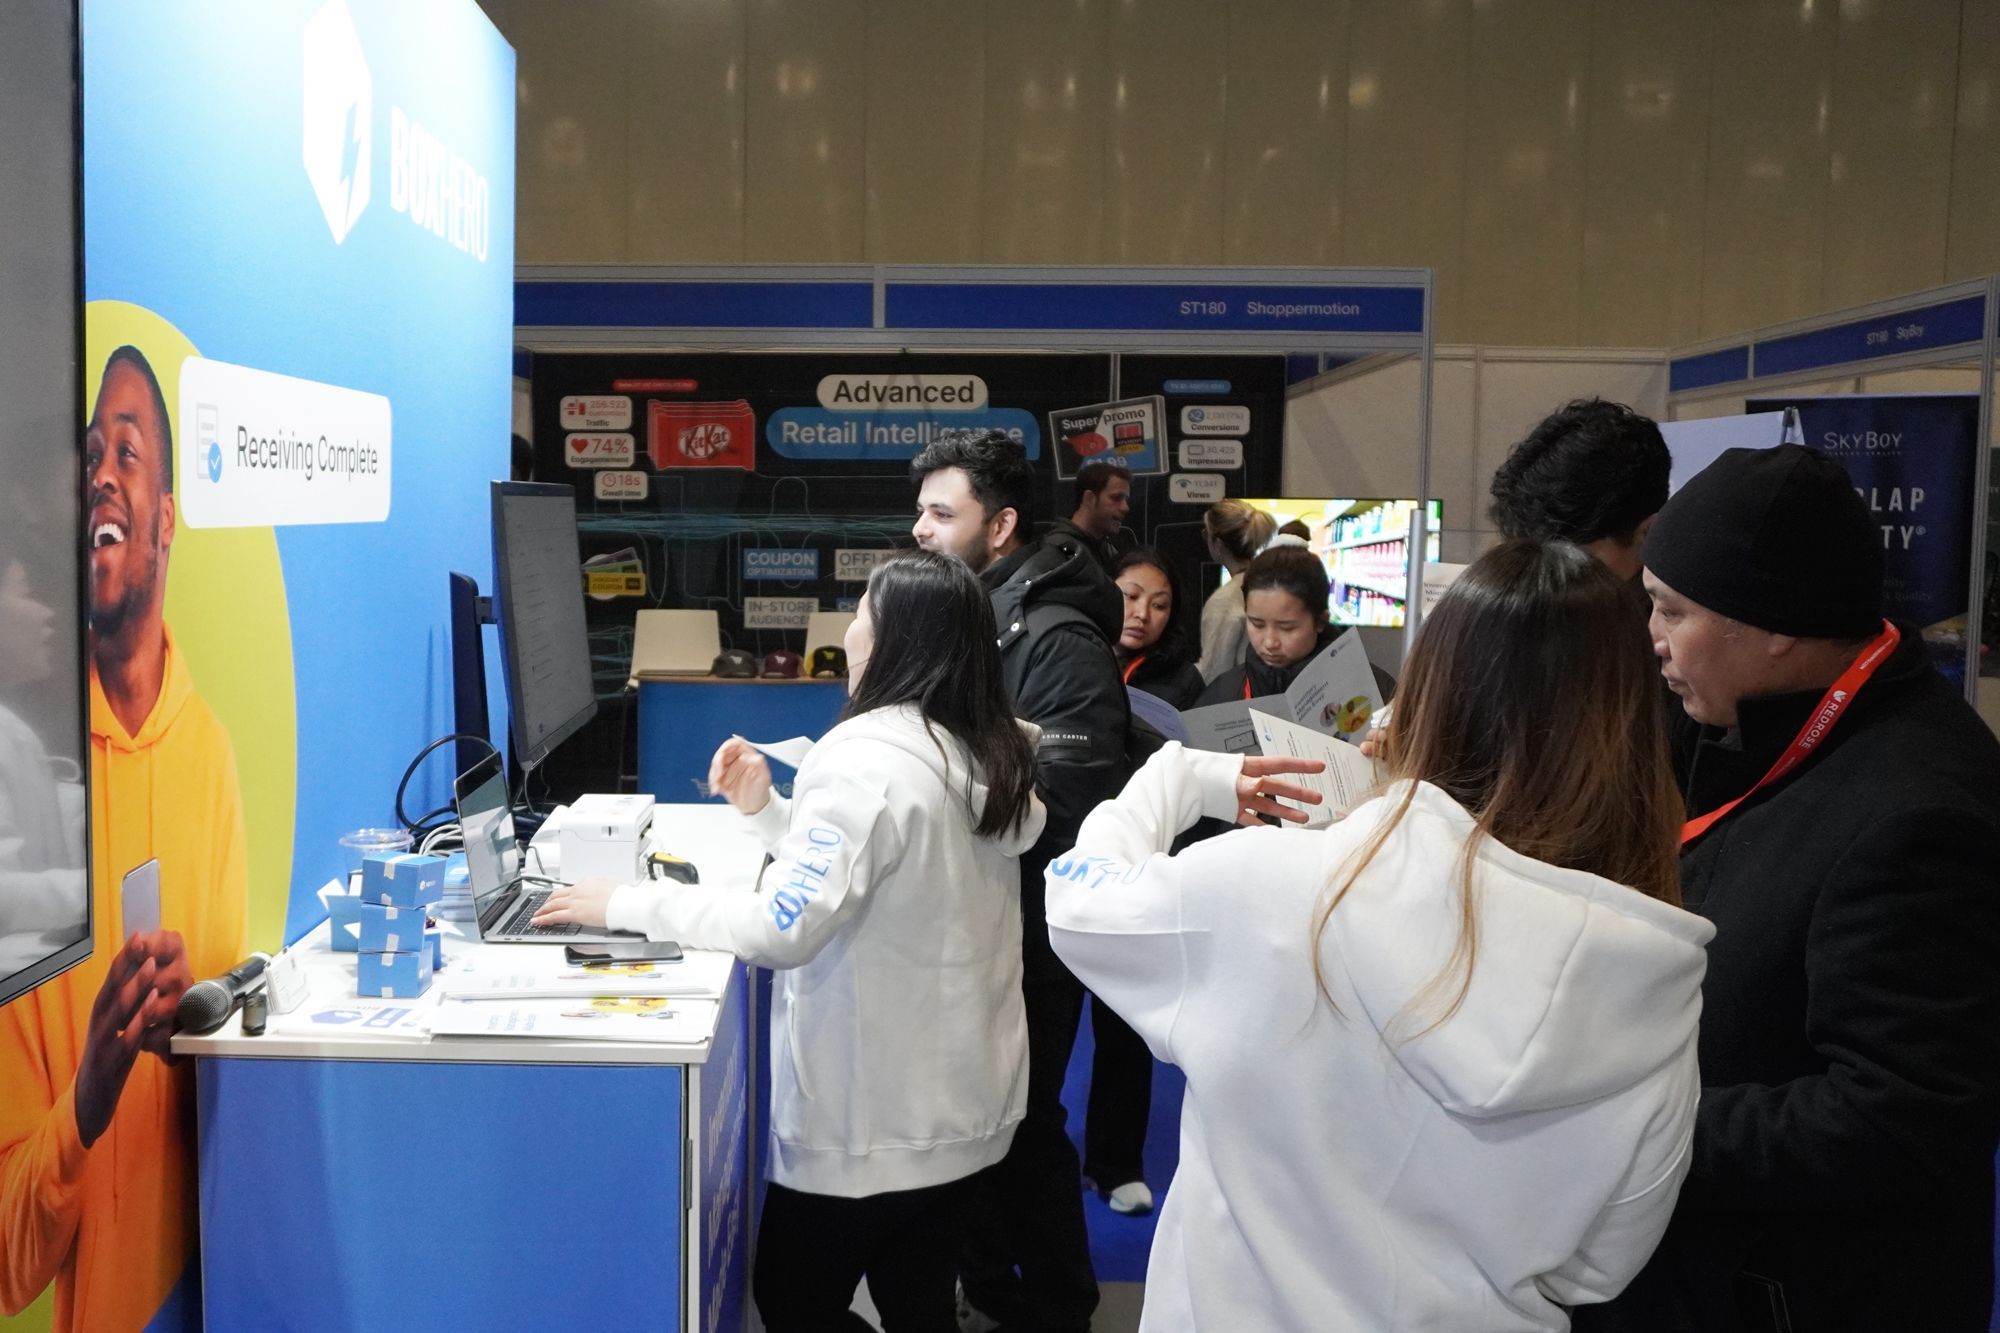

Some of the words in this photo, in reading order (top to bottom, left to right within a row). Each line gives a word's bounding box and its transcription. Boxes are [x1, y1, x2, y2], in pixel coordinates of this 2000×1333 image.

[390, 104, 488, 262] BOXHERO
[1180, 302, 1227, 315] ST180
[1247, 301, 1360, 317] Shoppermotion
[832, 380, 974, 403] Advanced
[1061, 417, 1099, 431] Super
[1102, 408, 1146, 425] promo
[1191, 423, 1240, 432] Conversions
[684, 424, 729, 457] KitKat
[782, 421, 858, 445] Retail
[237, 425, 314, 481] Receiving
[318, 435, 378, 482] Complete
[592, 439, 629, 455] 74%
[1187, 458, 1235, 466] Impressions
[619, 475, 641, 487] 18s
[1186, 491, 1211, 499] Views
[1853, 487, 1926, 512] LAP
[747, 552, 816, 566] COUPON
[746, 567, 816, 577] OPTIMIZATION
[748, 601, 815, 614] IN-STORE
[748, 615, 810, 626] AUDIENCE
[1801, 702, 1840, 750] REDROSE
[1062, 733, 1089, 741] CARTER
